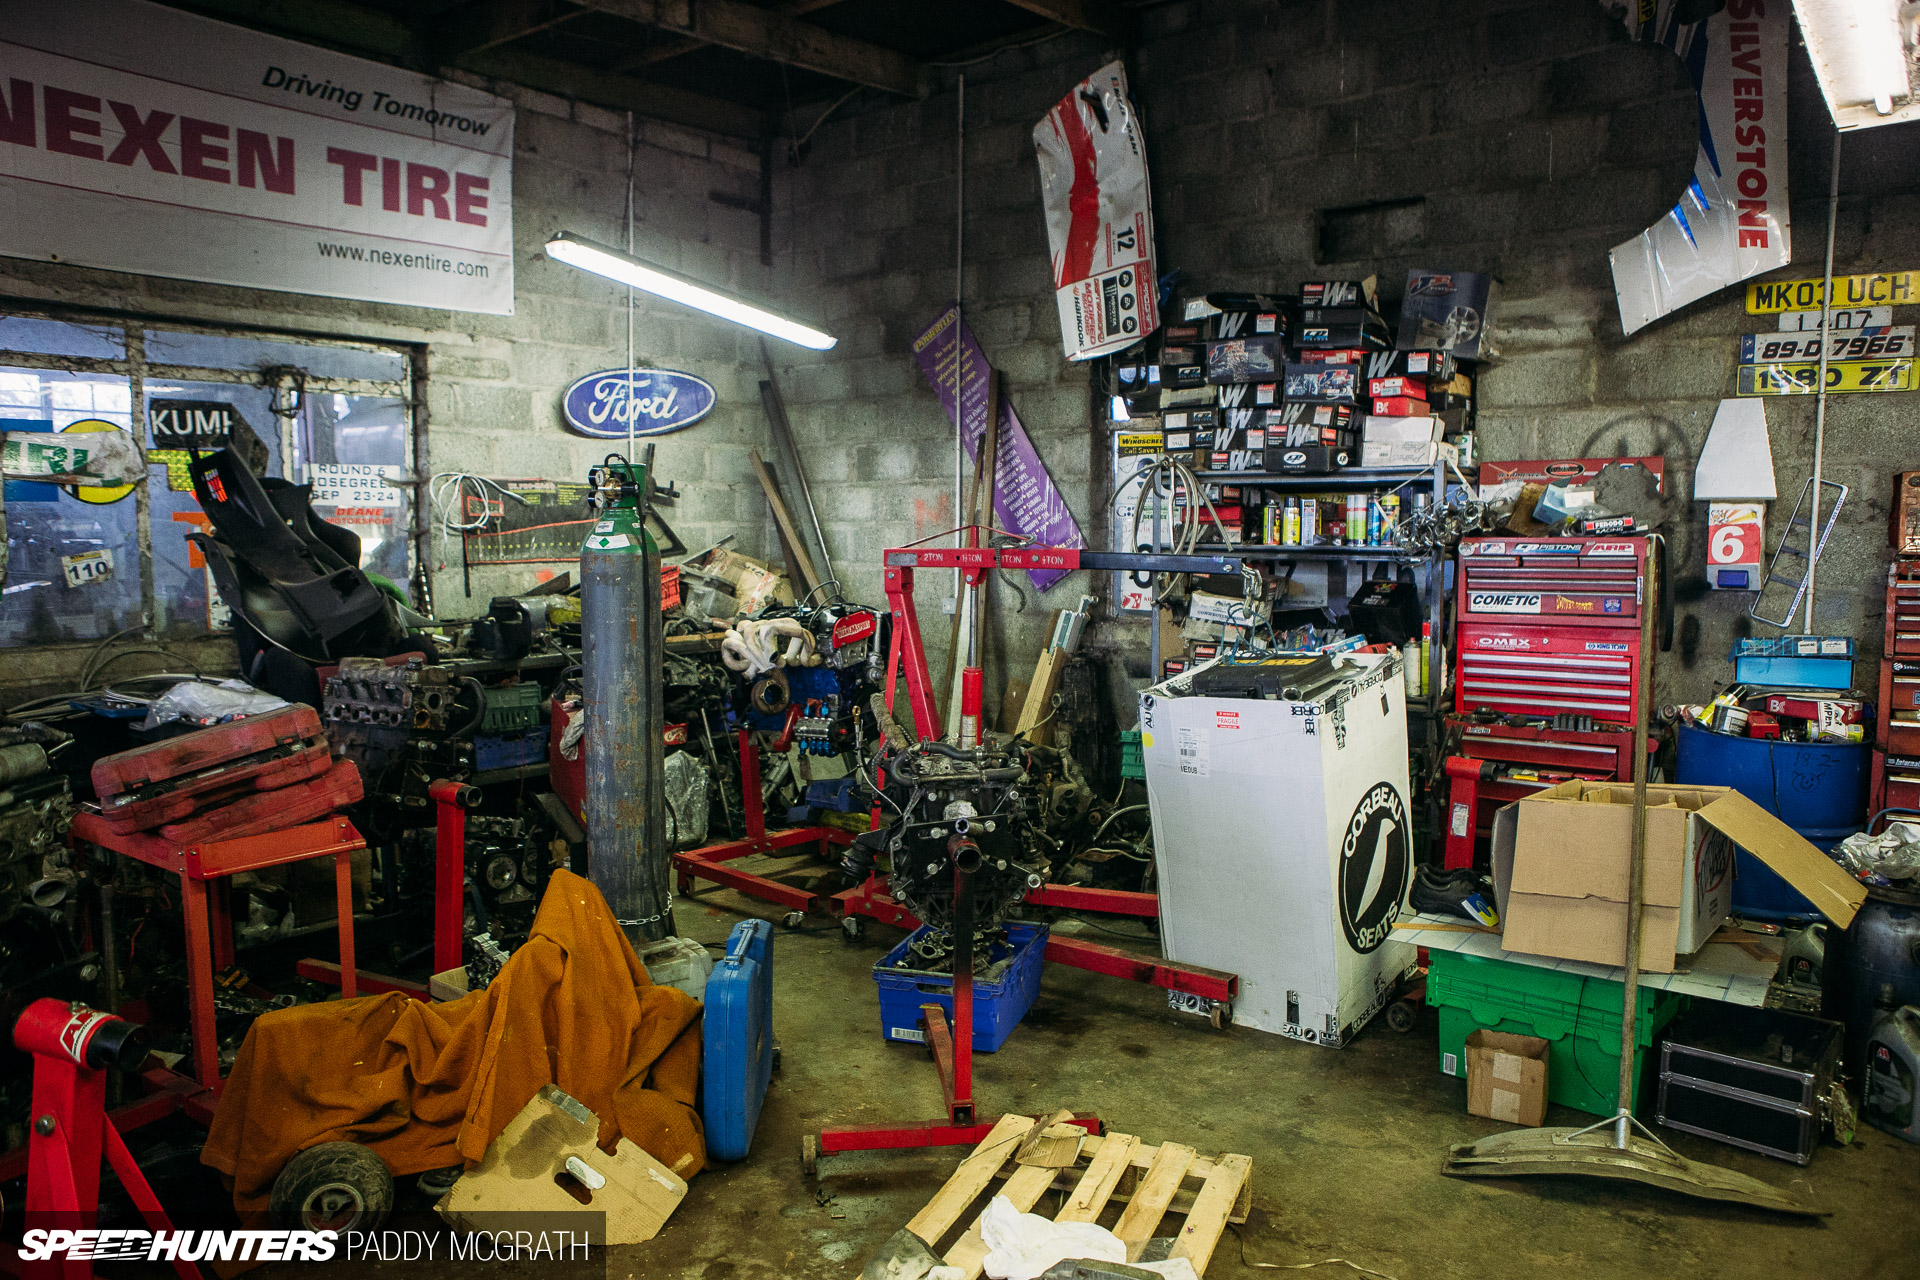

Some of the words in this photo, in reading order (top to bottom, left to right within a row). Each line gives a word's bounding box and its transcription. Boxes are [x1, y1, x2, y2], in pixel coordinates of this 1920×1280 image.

[262, 66, 361, 111] Driving
[372, 92, 491, 137] Tomorrow
[1727, 0, 1770, 249] SILVERSTONE
[0, 77, 296, 196] NEXEN
[327, 146, 490, 228] TIRE
[1117, 226, 1136, 252] 12
[318, 241, 490, 279] www.nexentire.com
[1847, 274, 1911, 303] UCH
[1085, 282, 1096, 345] MODIFIED
[914, 312, 956, 353] POWERFLEX
[1762, 335, 1907, 359] 89-D7966
[588, 378, 679, 424] Ford
[1138, 447, 1155, 455] Save
[318, 464, 372, 476] ROUND
[378, 466, 386, 476] 6
[1020, 476, 1038, 492] PORSCHE
[1026, 486, 1040, 499] ROVER
[312, 491, 340, 501] SEP
[335, 508, 384, 517] DEANE
[1595, 520, 1624, 529] FERODO
[1595, 527, 1625, 535] RACING
[1539, 544, 1583, 552] PISTONS
[1593, 544, 1633, 552] ARP
[1711, 526, 1745, 564] 6
[923, 553, 944, 562] 2TON
[68, 561, 108, 580] 110
[1472, 594, 1540, 606] COMETIC
[1478, 637, 1531, 647] OMEX
[1217, 717, 1240, 725] FRAGILE
[1344, 786, 1403, 858] CORBEAU
[1357, 900, 1399, 950] SEATS
